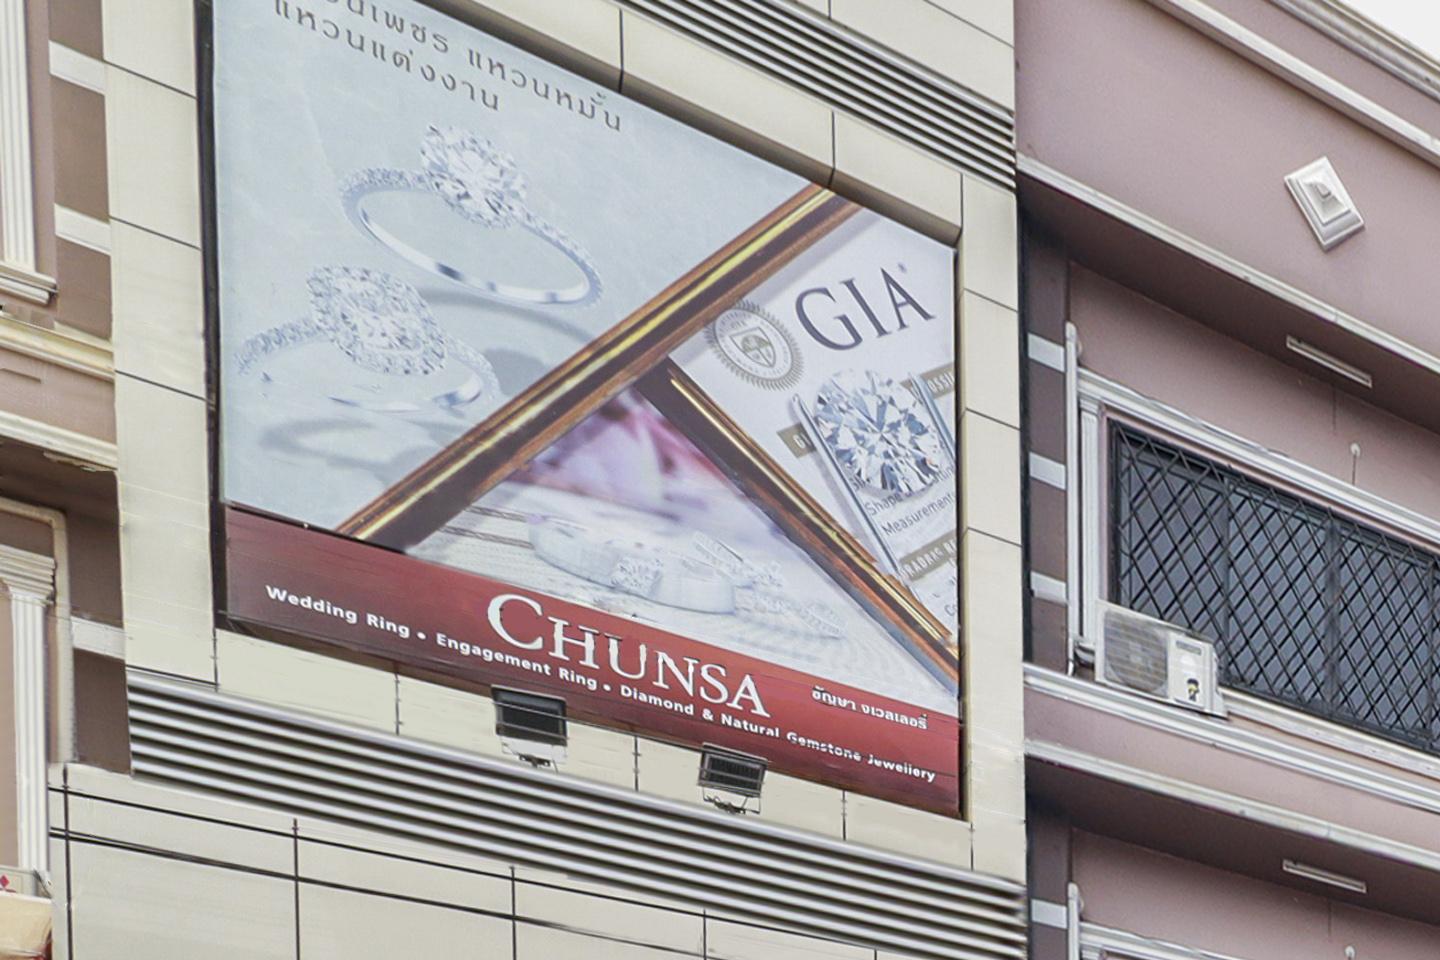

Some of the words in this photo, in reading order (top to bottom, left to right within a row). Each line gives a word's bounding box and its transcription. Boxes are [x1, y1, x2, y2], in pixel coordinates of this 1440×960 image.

[795, 267, 936, 350] GIA
[265, 584, 358, 625] Wedding
[366, 612, 411, 639] Ring
[436, 632, 551, 675] Engagement
[558, 667, 598, 691] Ring
[620, 684, 695, 716] Diamond
[702, 708, 715, 722] &
[720, 713, 781, 739] Natural
[786, 730, 862, 762] Gemstone
[487, 593, 771, 718] CHUNSA
